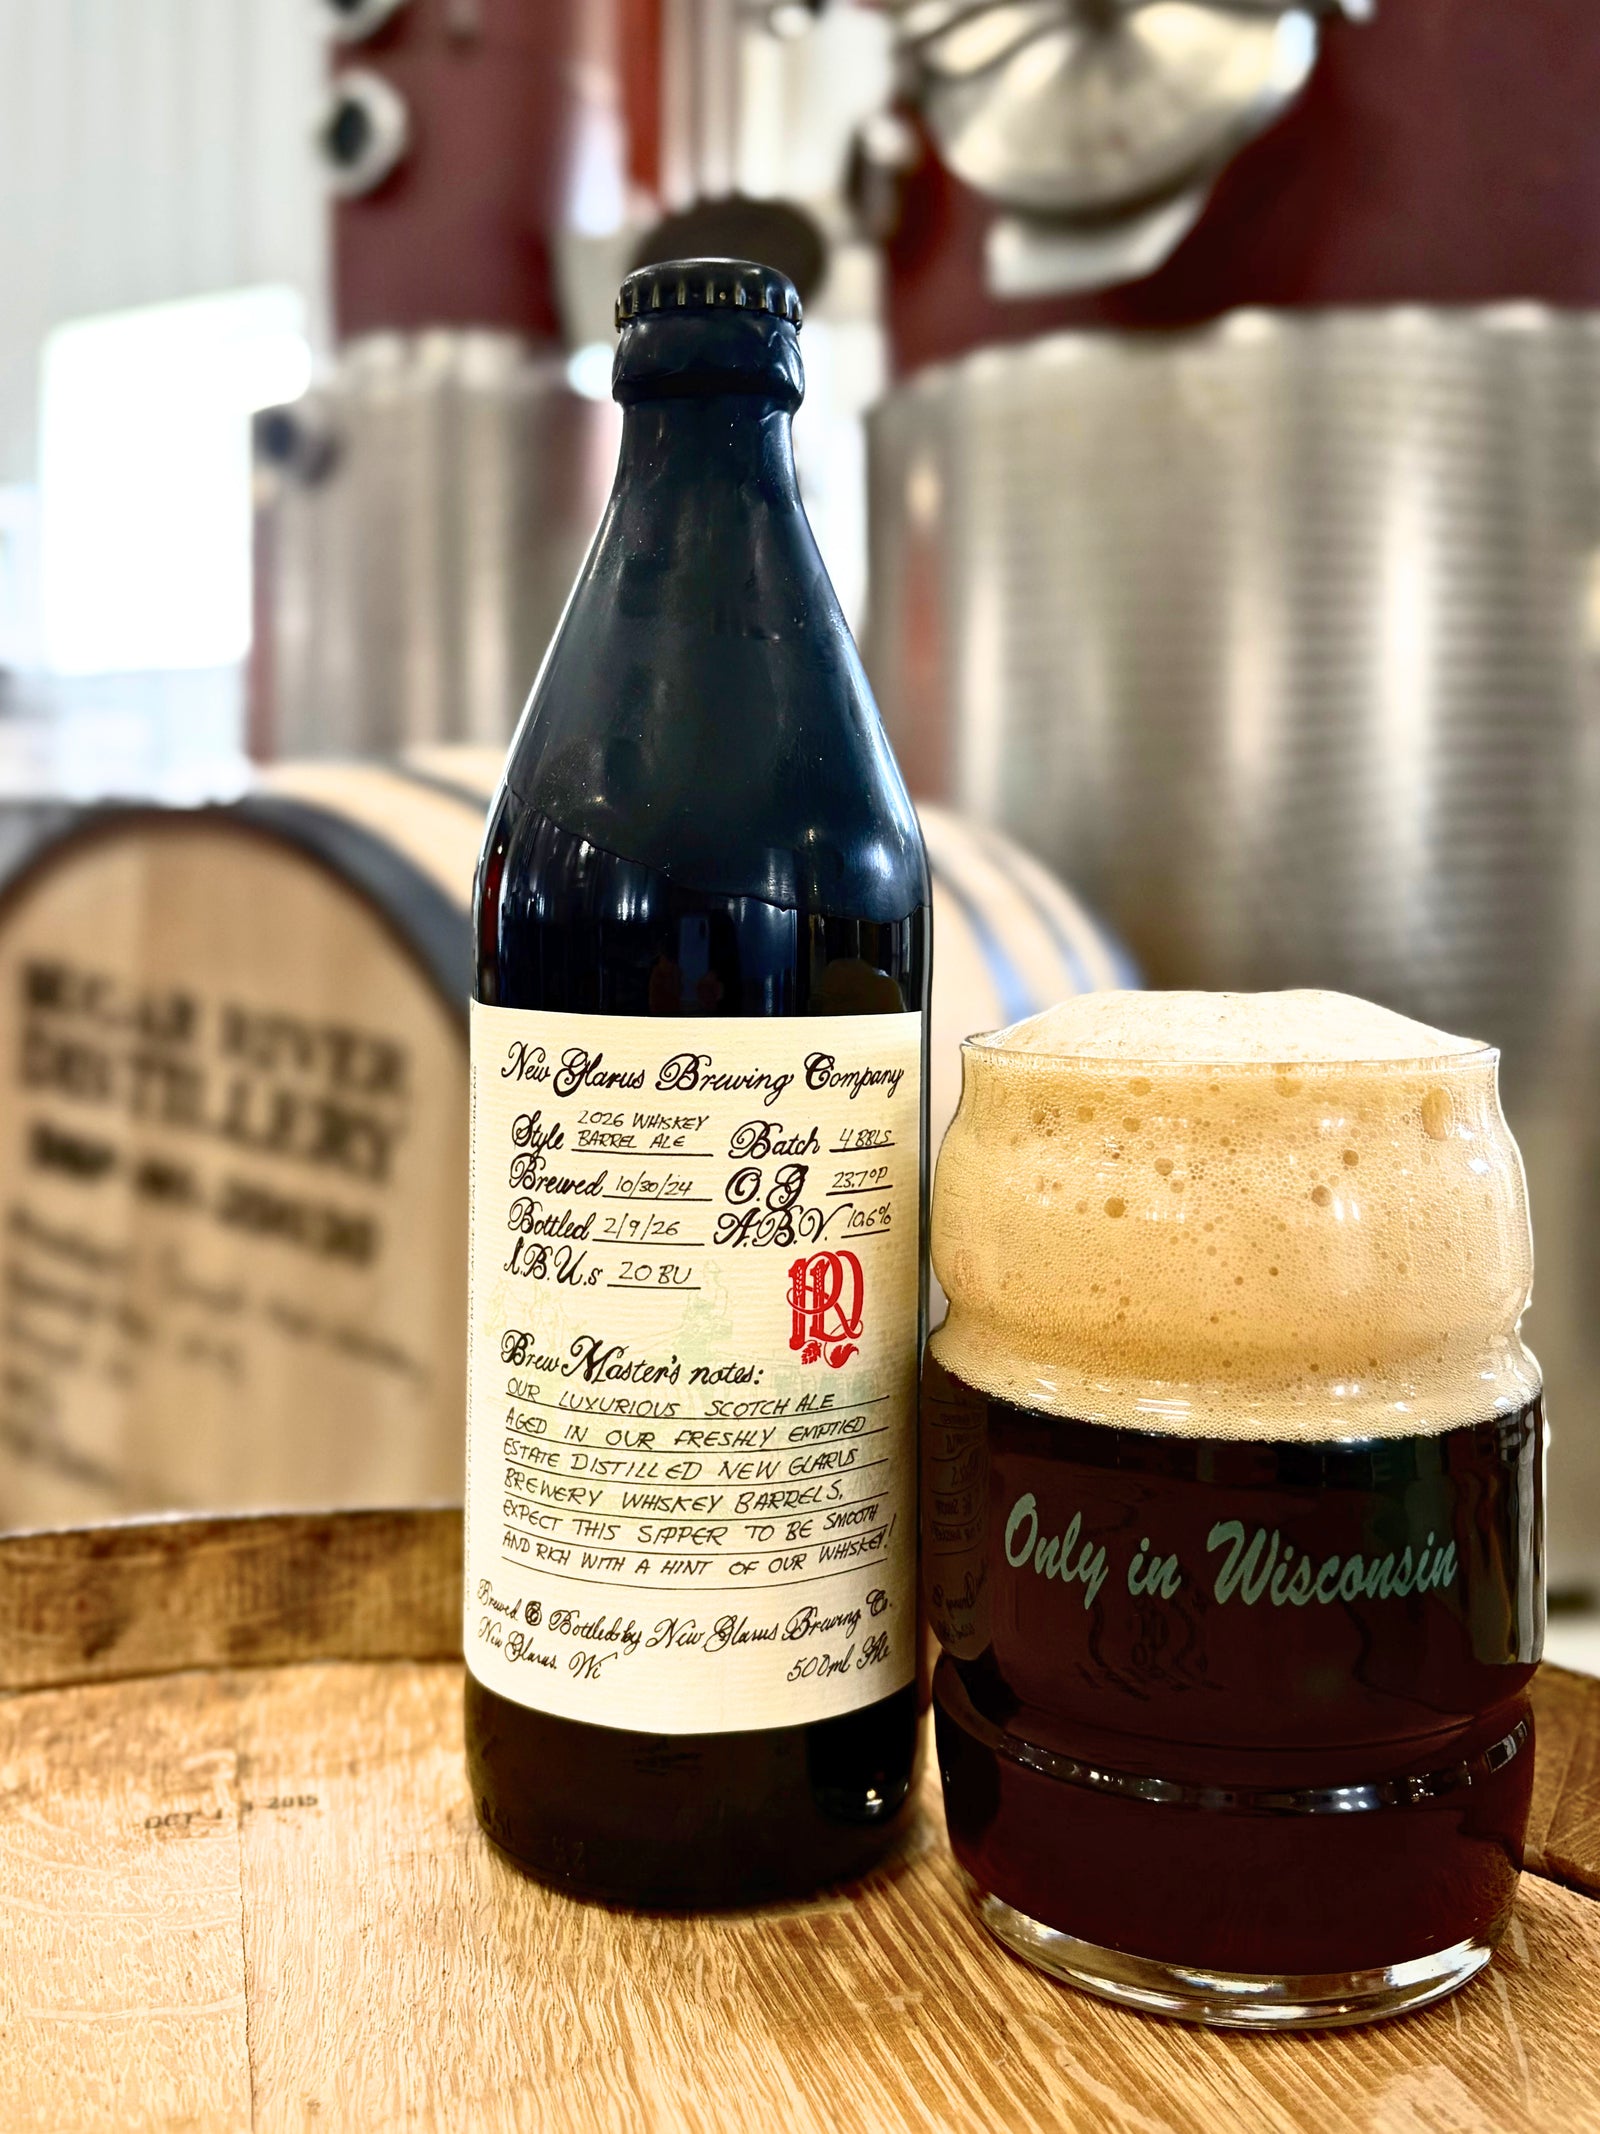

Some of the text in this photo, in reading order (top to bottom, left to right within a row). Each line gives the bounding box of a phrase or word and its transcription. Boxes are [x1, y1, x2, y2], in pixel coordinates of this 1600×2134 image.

[501, 1041, 904, 1106] New Glarus Brewing Company
[512, 1110, 685, 1159] Style BARREL ALE
[577, 1110, 709, 1131] 2026 WHISKEY
[728, 1120, 820, 1159] Batch
[509, 1152, 693, 1198] Brewed 10/30/24
[507, 1196, 680, 1240] Bottled 2/9/26
[501, 1329, 764, 1385] Brew Master's notes:
[507, 1377, 835, 1418] OUR LUXURIOUS SCOTCH ALE
[506, 1406, 866, 1450] AGED IN OUR FRESHLY EMPTIED
[503, 1437, 858, 1481] ESTATE DISTILLED NEW GLARUS
[504, 1467, 603, 1507] BREWERY
[621, 1491, 723, 1514] WHISKEY
[503, 1499, 879, 1545] EXPECT THIS SIPPER TO BE SMOOTH
[503, 1531, 530, 1553] AND
[536, 1543, 571, 1566] RICH
[581, 1552, 626, 1571] WITH
[634, 1559, 650, 1574] A
[660, 1560, 713, 1575] HINT
[728, 1560, 759, 1575] OF
[768, 1553, 807, 1574] OUR
[1005, 1492, 1458, 1610] Only in Wisconsin
[477, 1578, 522, 1621] Brewed
[645, 1618, 705, 1648] New
[701, 1615, 779, 1652] Glarus
[781, 1606, 861, 1641] Brewing
[478, 1616, 502, 1648] New
[787, 1631, 890, 1682] 500ml Ale
